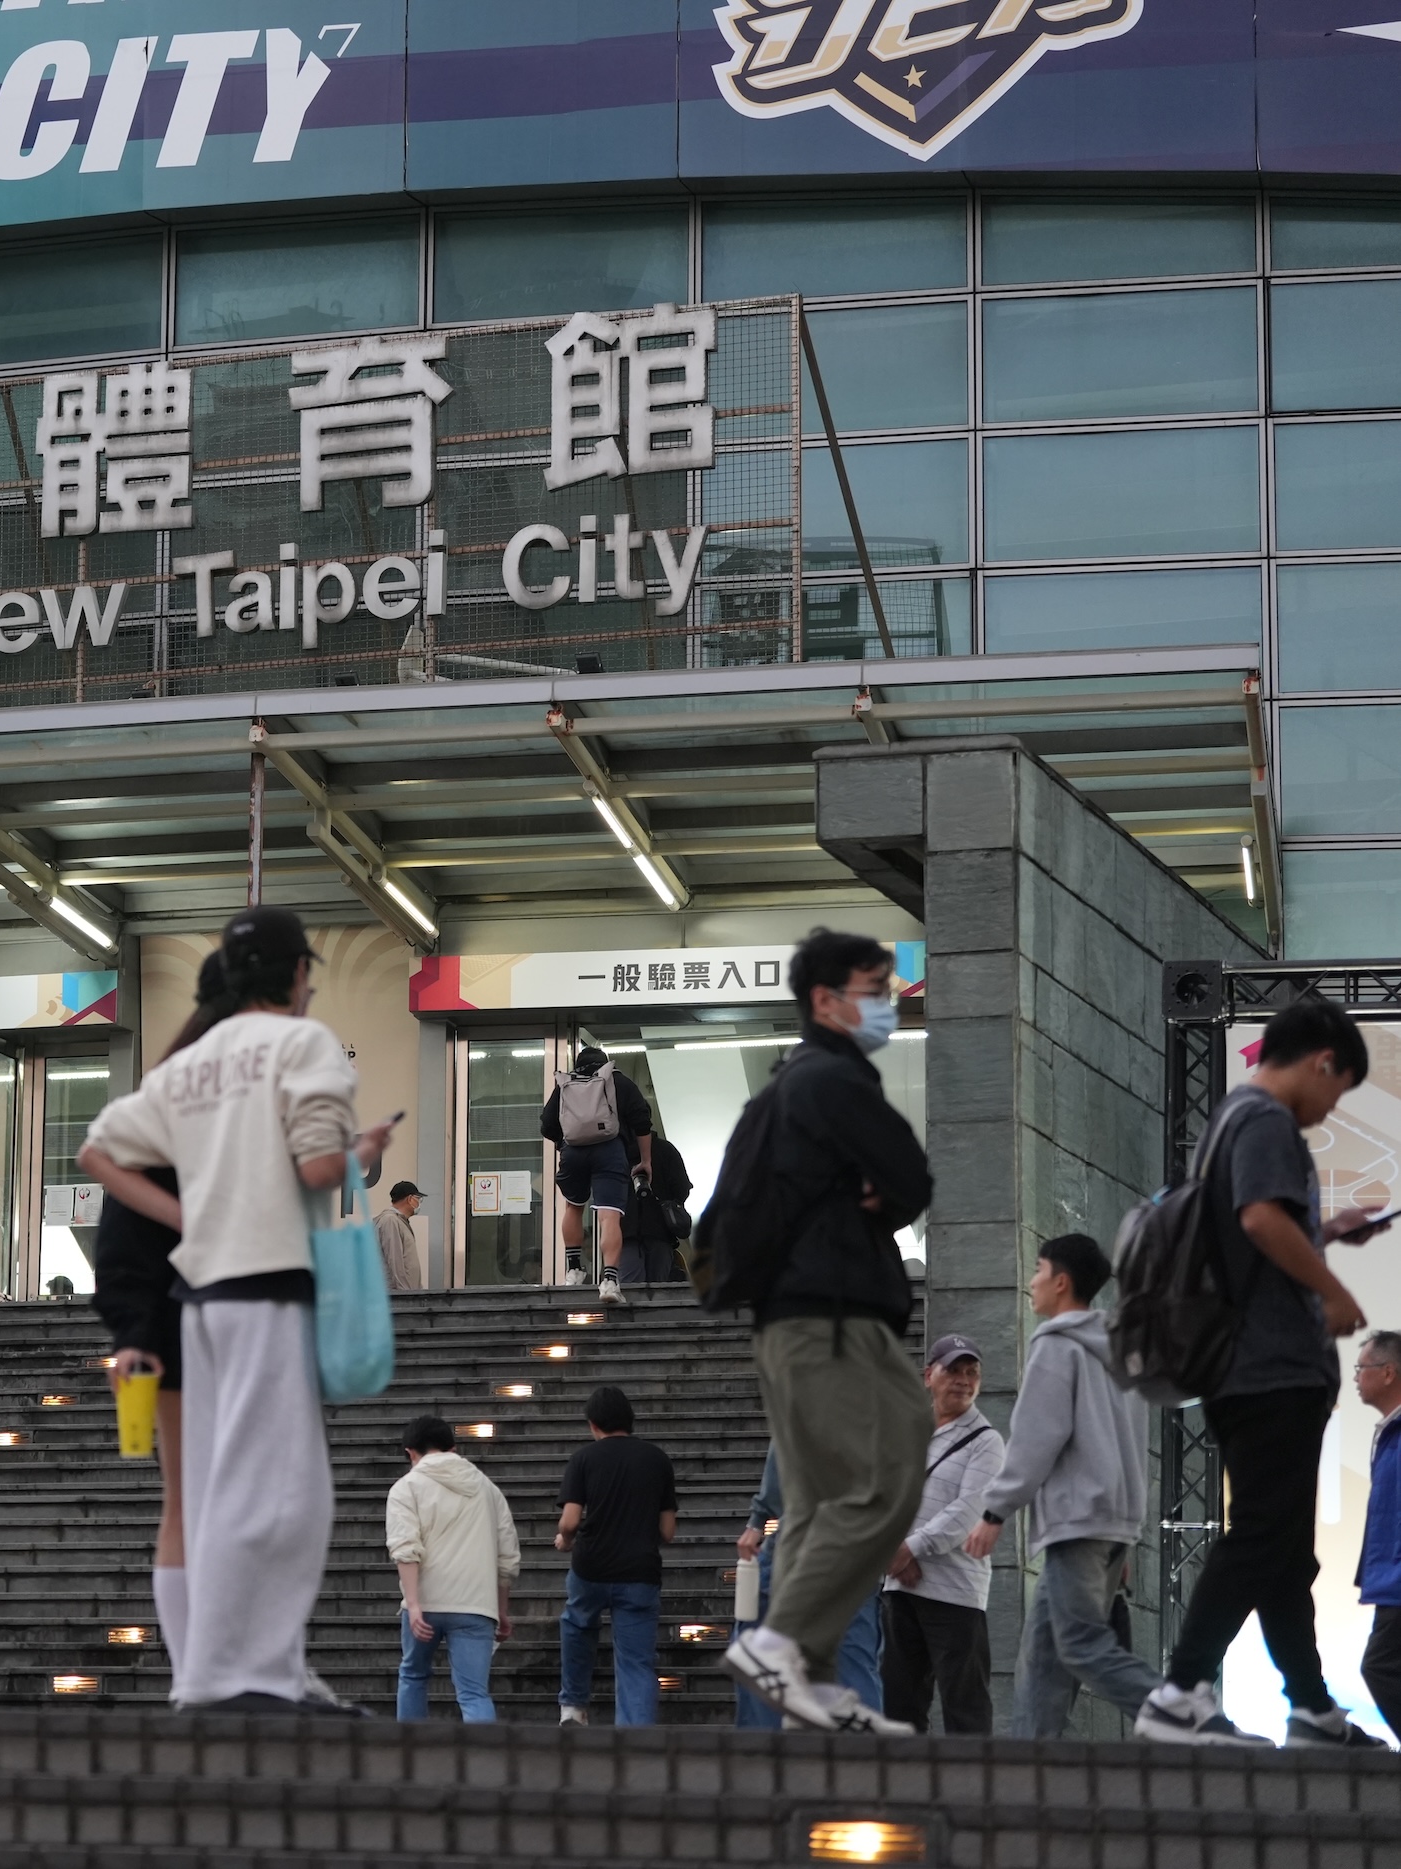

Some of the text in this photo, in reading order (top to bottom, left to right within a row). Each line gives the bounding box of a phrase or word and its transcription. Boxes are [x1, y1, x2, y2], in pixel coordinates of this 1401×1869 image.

[172, 528, 448, 649] Taipei
[502, 513, 710, 617] City
[578, 960, 781, 993] 一般驗票入口
